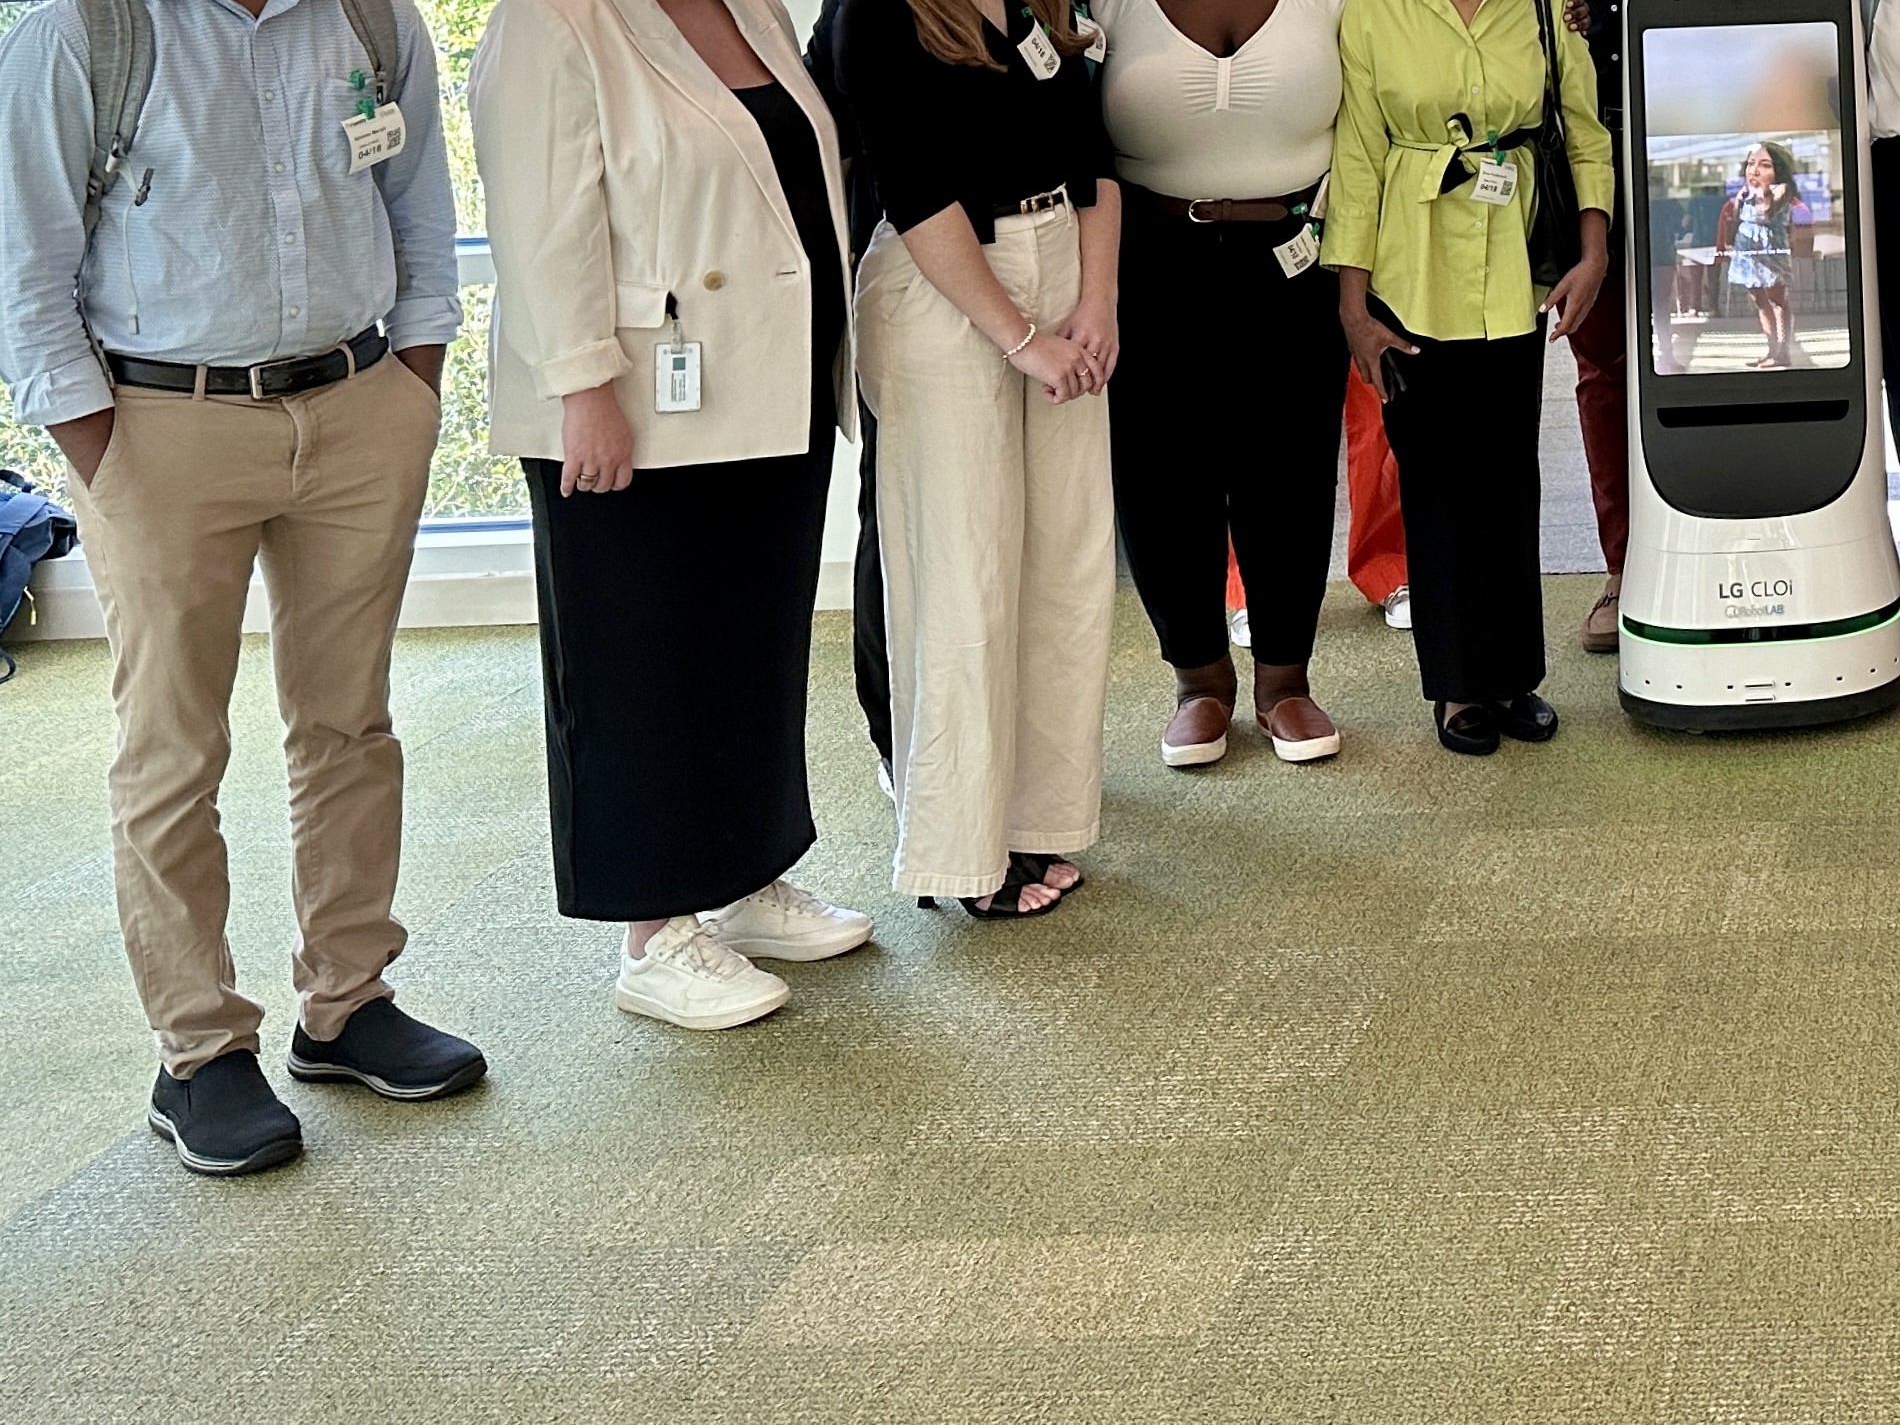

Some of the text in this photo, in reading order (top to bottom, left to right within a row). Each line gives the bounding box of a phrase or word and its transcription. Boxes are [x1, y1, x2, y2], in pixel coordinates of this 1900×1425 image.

[358, 144, 382, 160] 04/18
[1719, 579, 1793, 600] LG CLOi
